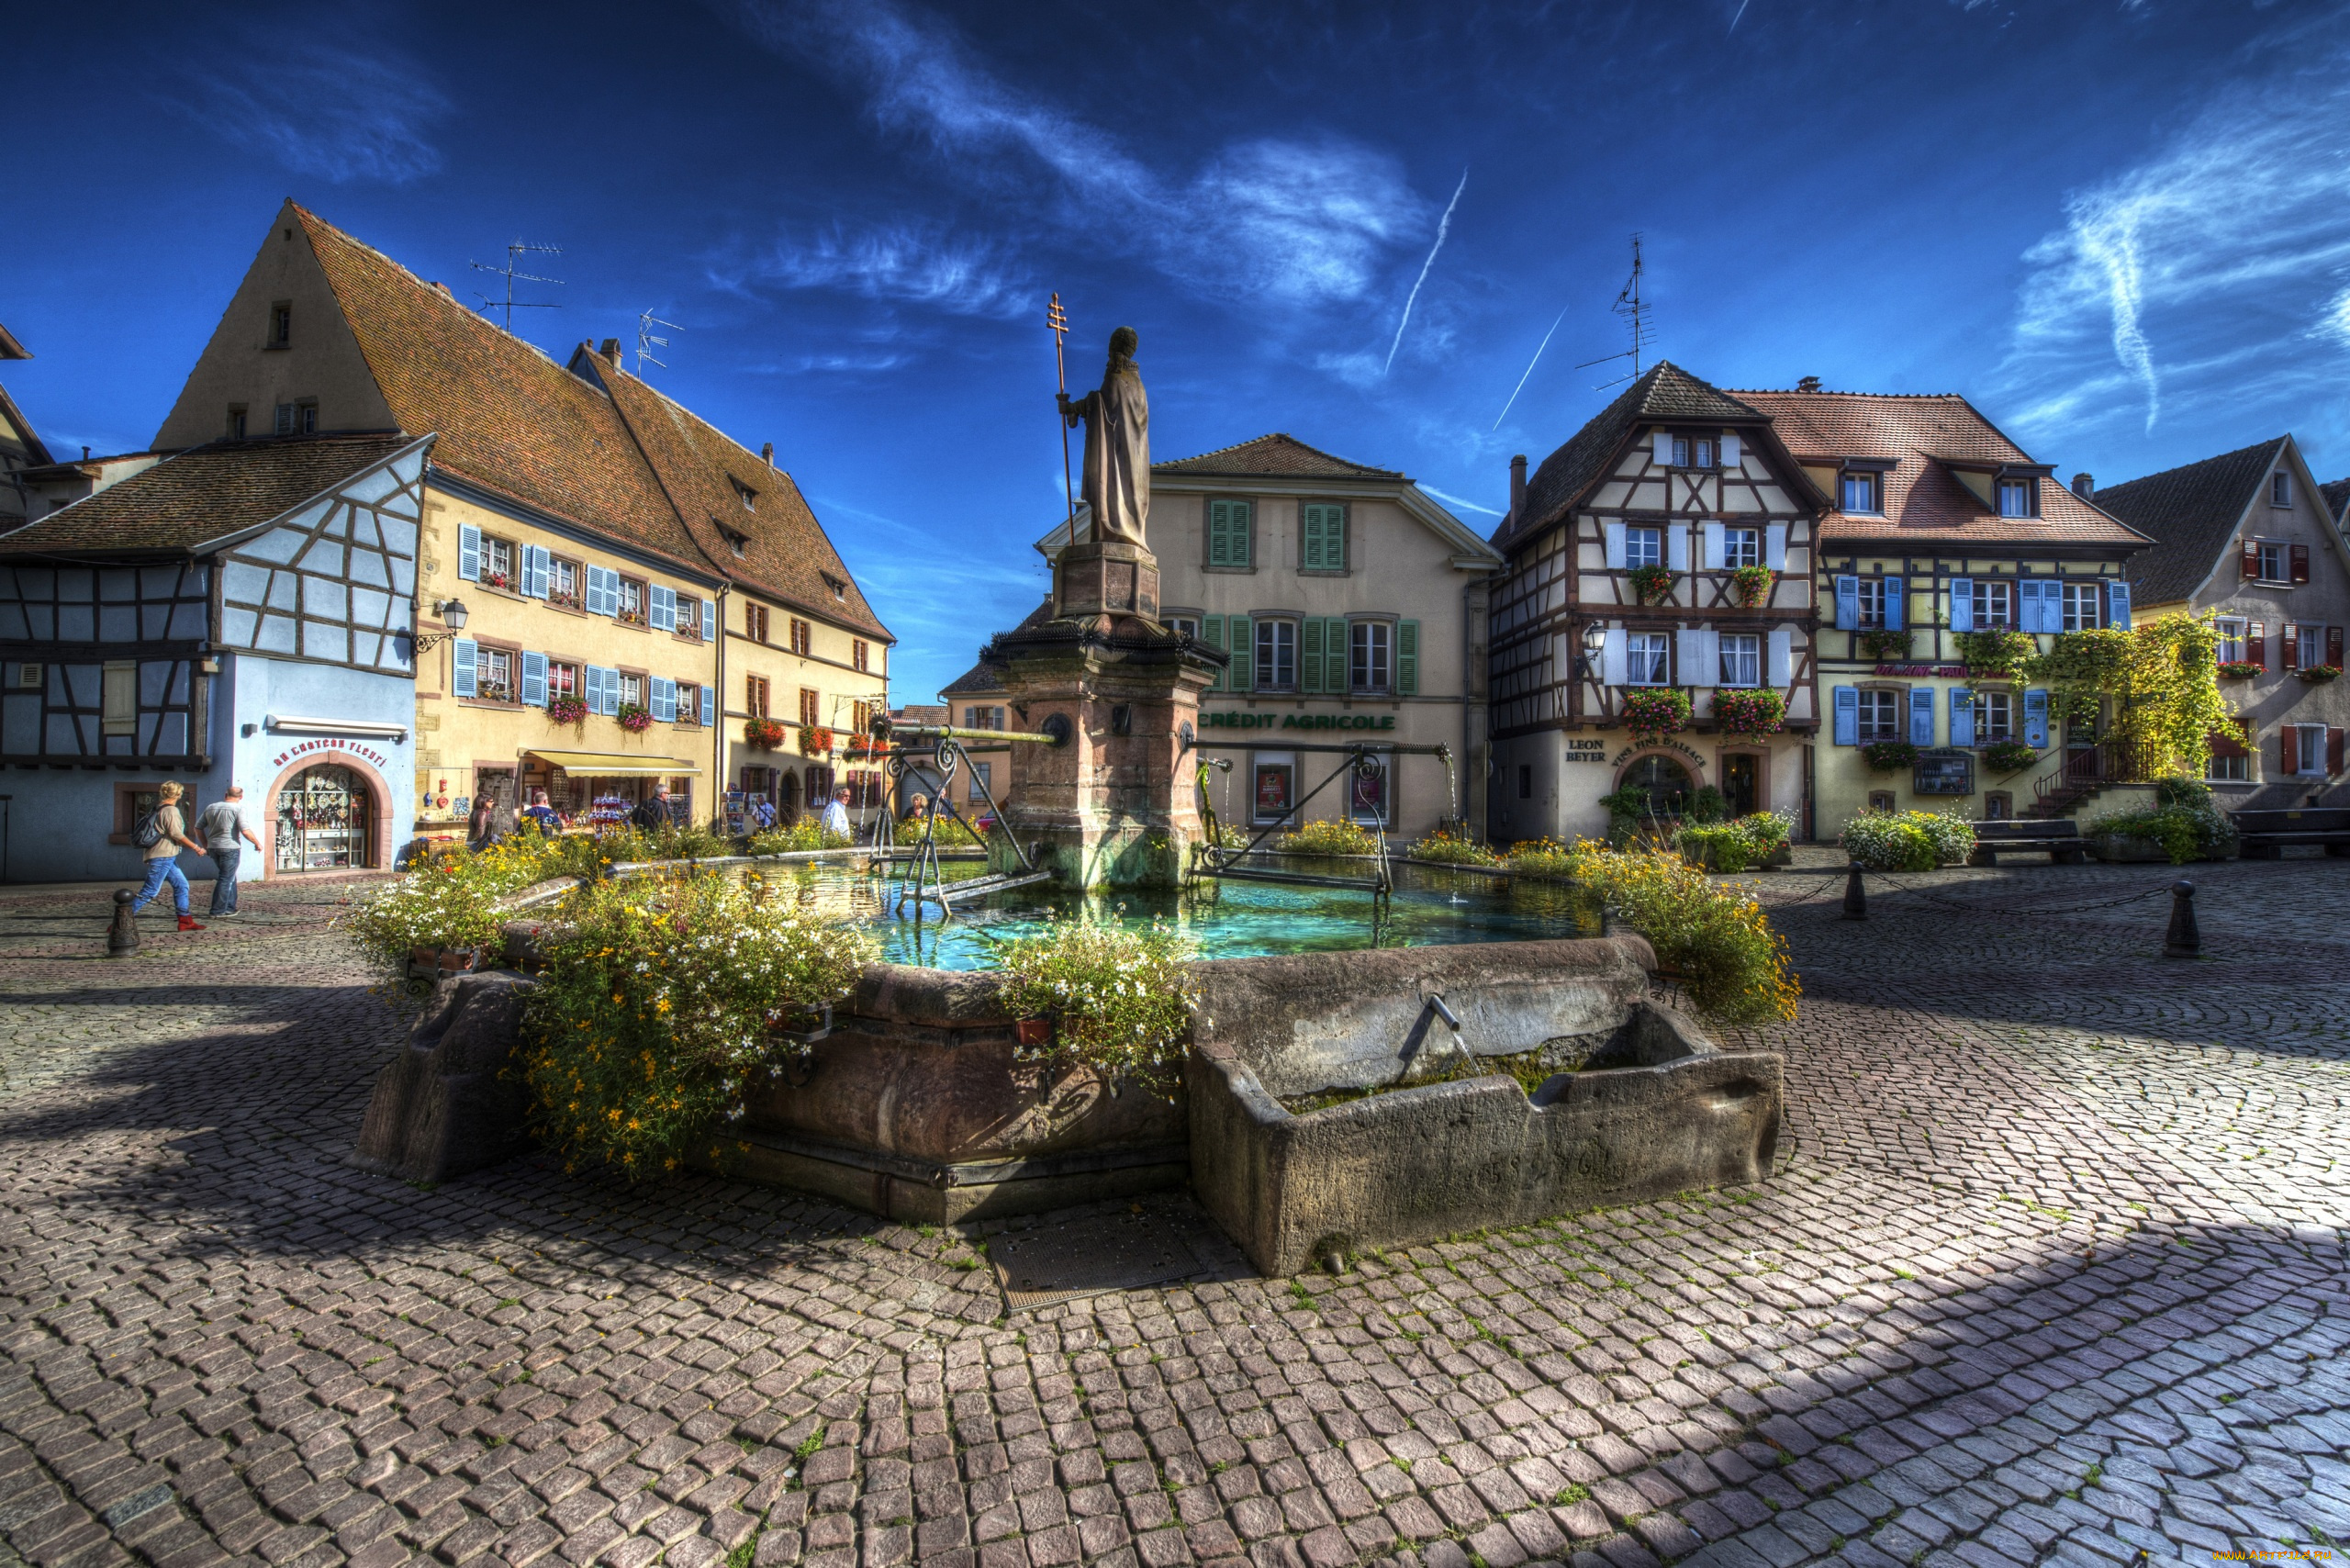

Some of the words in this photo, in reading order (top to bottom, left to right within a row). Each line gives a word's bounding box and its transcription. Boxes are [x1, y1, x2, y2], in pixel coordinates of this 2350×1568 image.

[1874, 665, 1934, 677] DOMAINE
[1939, 666, 1970, 678] PAUL
[1197, 711, 1277, 728] CRÉDIT
[1281, 714, 1395, 730] AGRICOLE
[1568, 740, 1604, 750] LEON
[1566, 752, 1606, 762] BEYER
[1611, 747, 1632, 767] VINS
[1635, 737, 1658, 749] FINS
[1662, 737, 1707, 768] D'ALSACE
